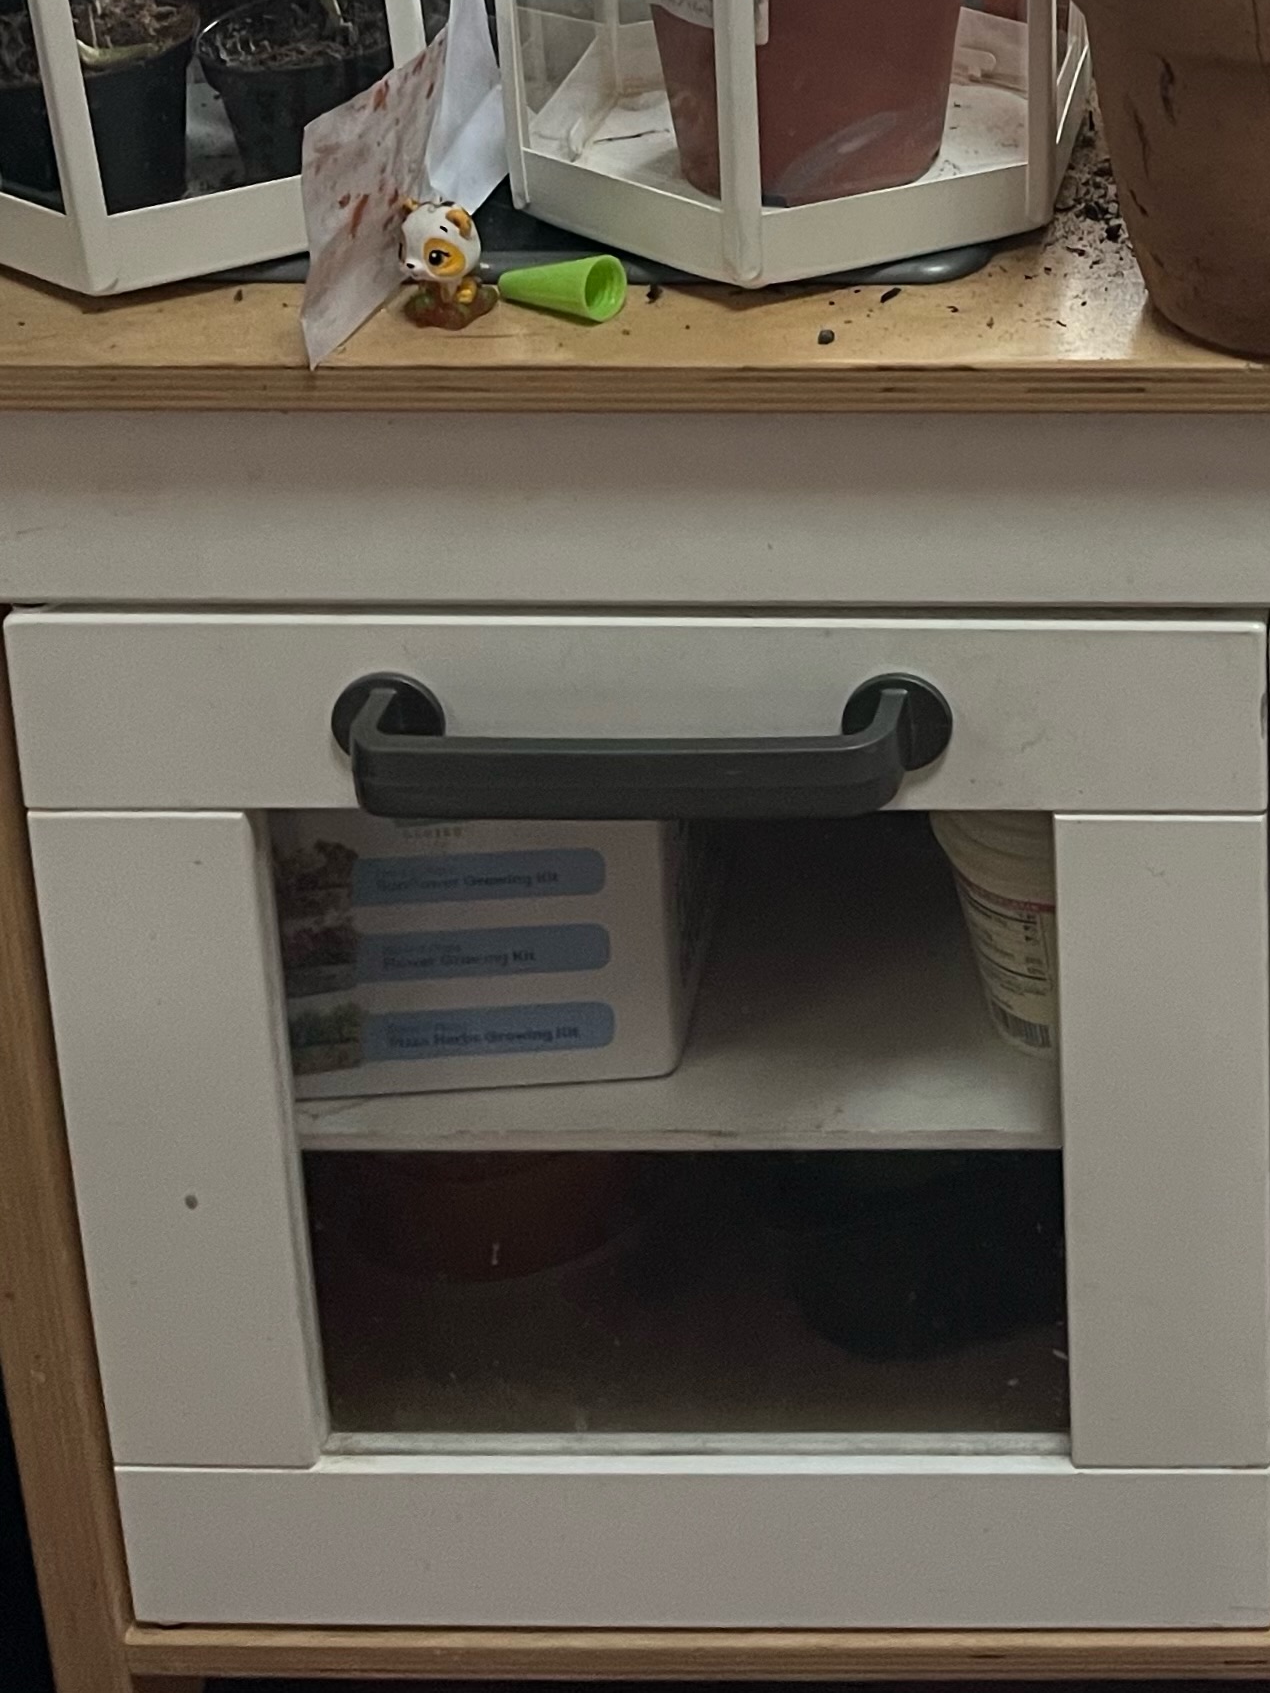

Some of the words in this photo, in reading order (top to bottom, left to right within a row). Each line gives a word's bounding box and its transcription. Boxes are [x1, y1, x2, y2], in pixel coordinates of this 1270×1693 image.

[536, 870, 559, 885] Kit
[512, 949, 535, 963] Kit
[555, 1025, 580, 1041] Kit
